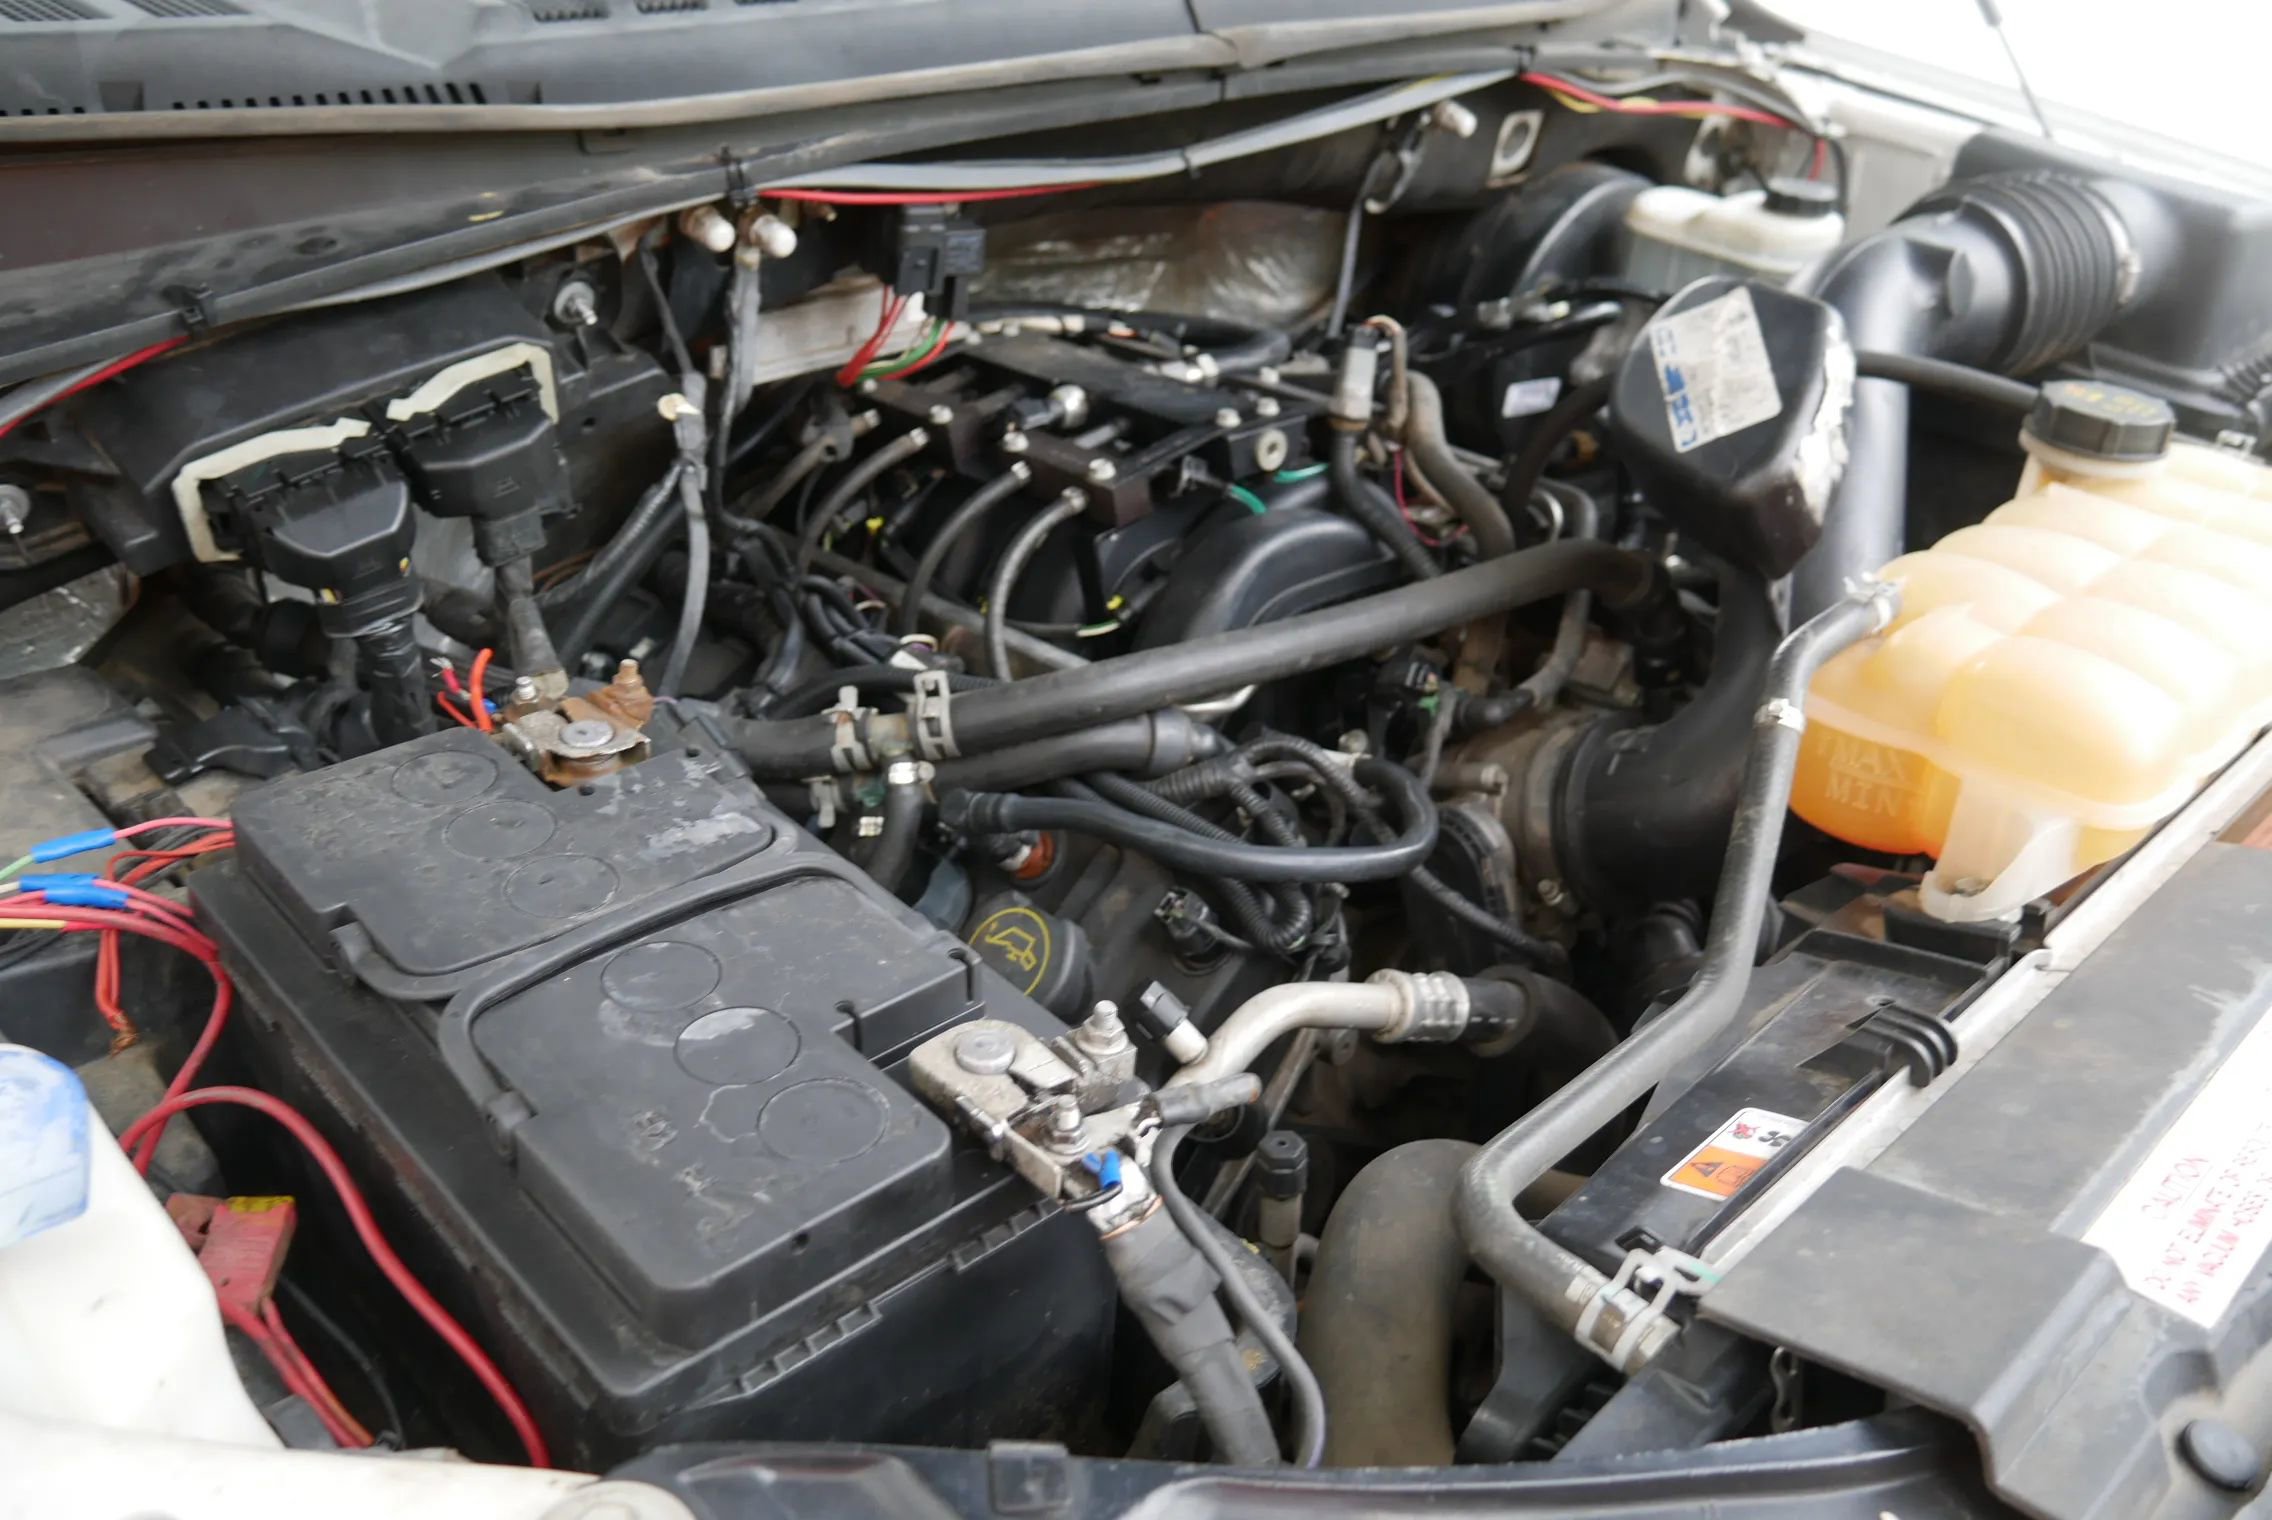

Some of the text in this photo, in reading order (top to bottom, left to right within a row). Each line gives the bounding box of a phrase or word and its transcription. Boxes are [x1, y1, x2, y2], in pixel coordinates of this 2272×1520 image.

[1829, 734, 1905, 782] MAX
[1824, 770, 1904, 817] MIN
[2141, 1155, 2209, 1220] CAUTION
